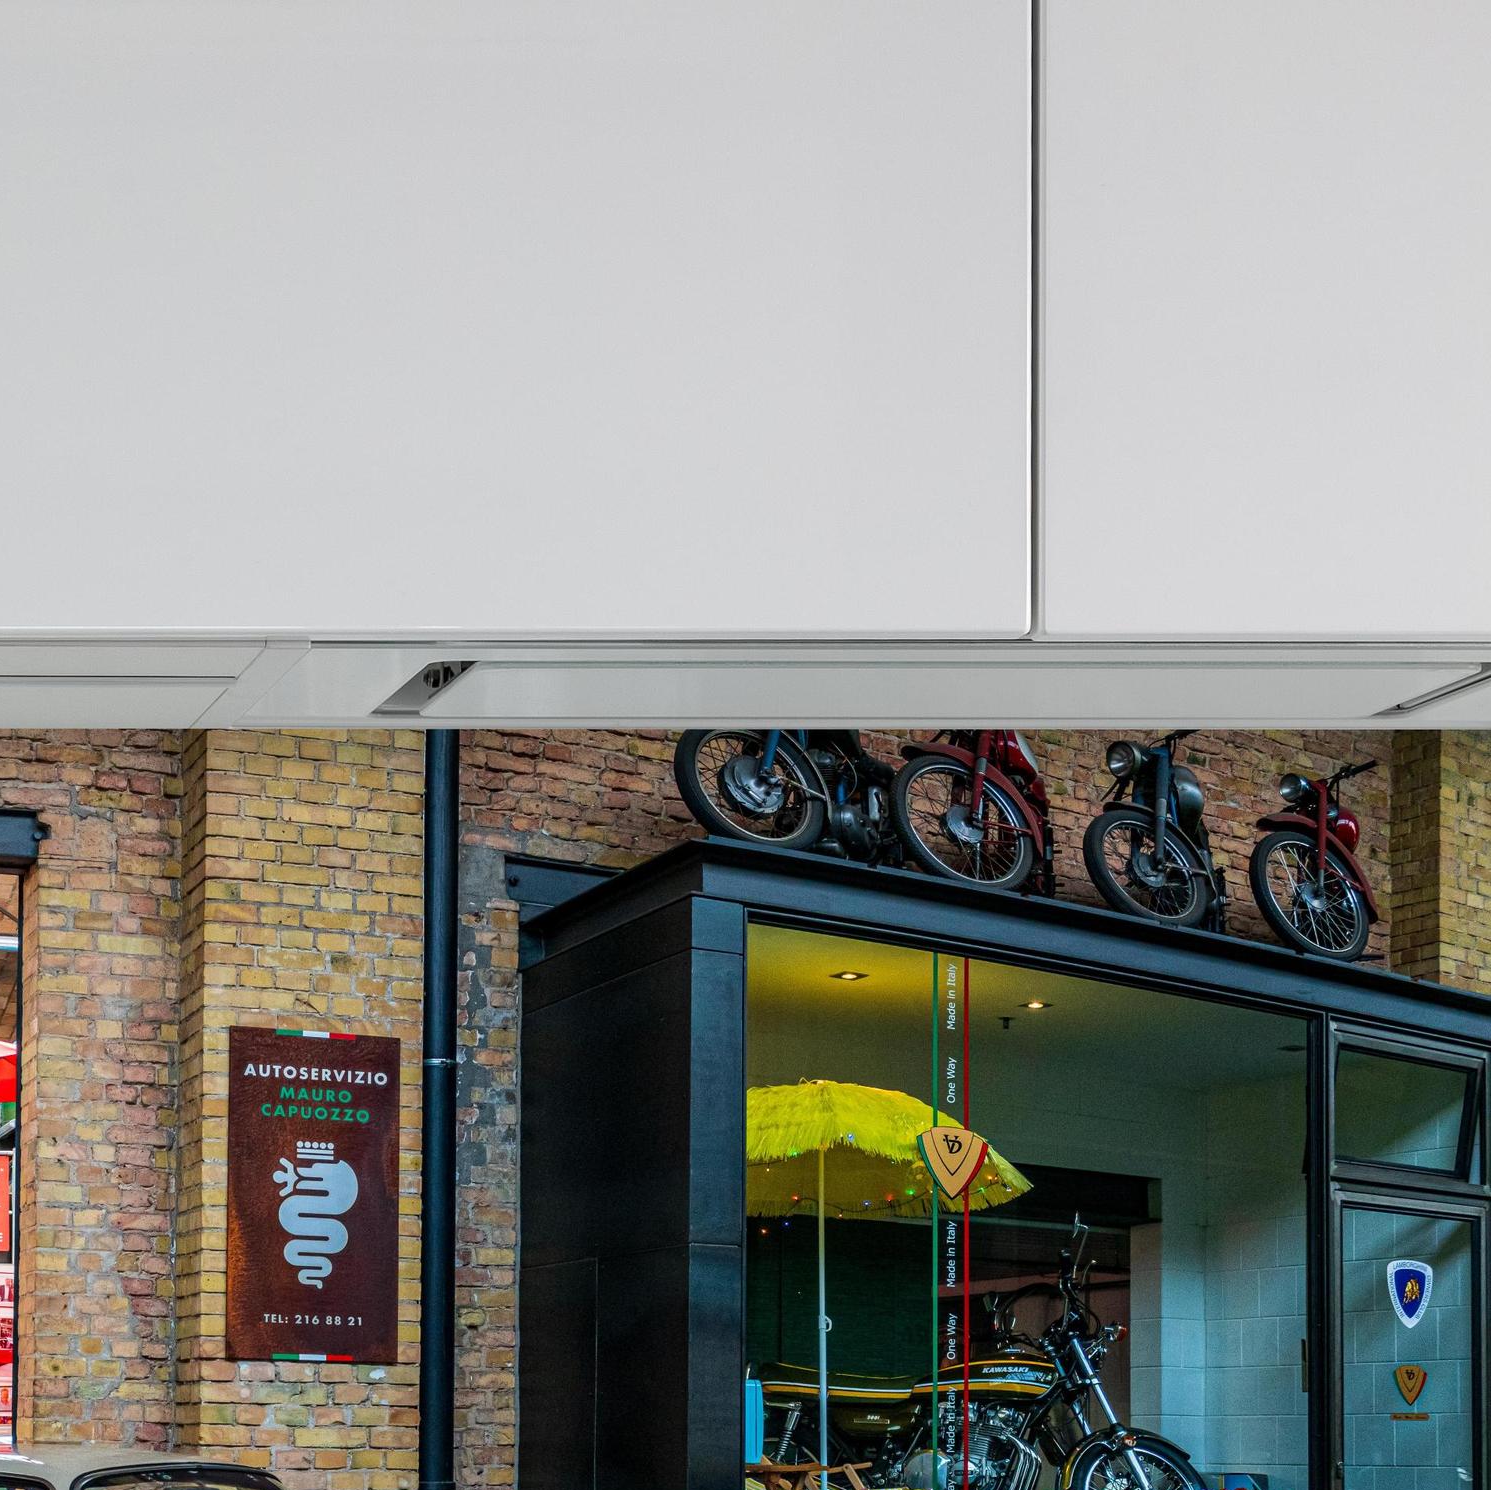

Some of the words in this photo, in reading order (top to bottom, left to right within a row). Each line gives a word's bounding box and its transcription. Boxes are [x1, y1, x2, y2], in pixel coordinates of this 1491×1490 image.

[946, 963, 958, 987] Italy
[946, 989, 956, 999] in
[946, 1001, 956, 1030] Made
[244, 1063, 388, 1086] AUTOSERVIZIO
[946, 1056, 958, 1080] Way
[280, 1086, 353, 1104] MAURO
[946, 1082, 956, 1104] One
[260, 1103, 370, 1124] CAPUOZZO
[946, 1220, 958, 1244] Italy
[946, 1247, 956, 1257] in
[946, 1259, 956, 1288] Made
[263, 1313, 289, 1324] TEL:
[295, 1314, 320, 1325] 216
[325, 1315, 341, 1326] 88
[347, 1316, 362, 1326] 21
[946, 1312, 958, 1338] Way
[946, 1339, 956, 1360] One
[982, 1366, 1030, 1374] KAWASAKI
[946, 1425, 956, 1453] Made
